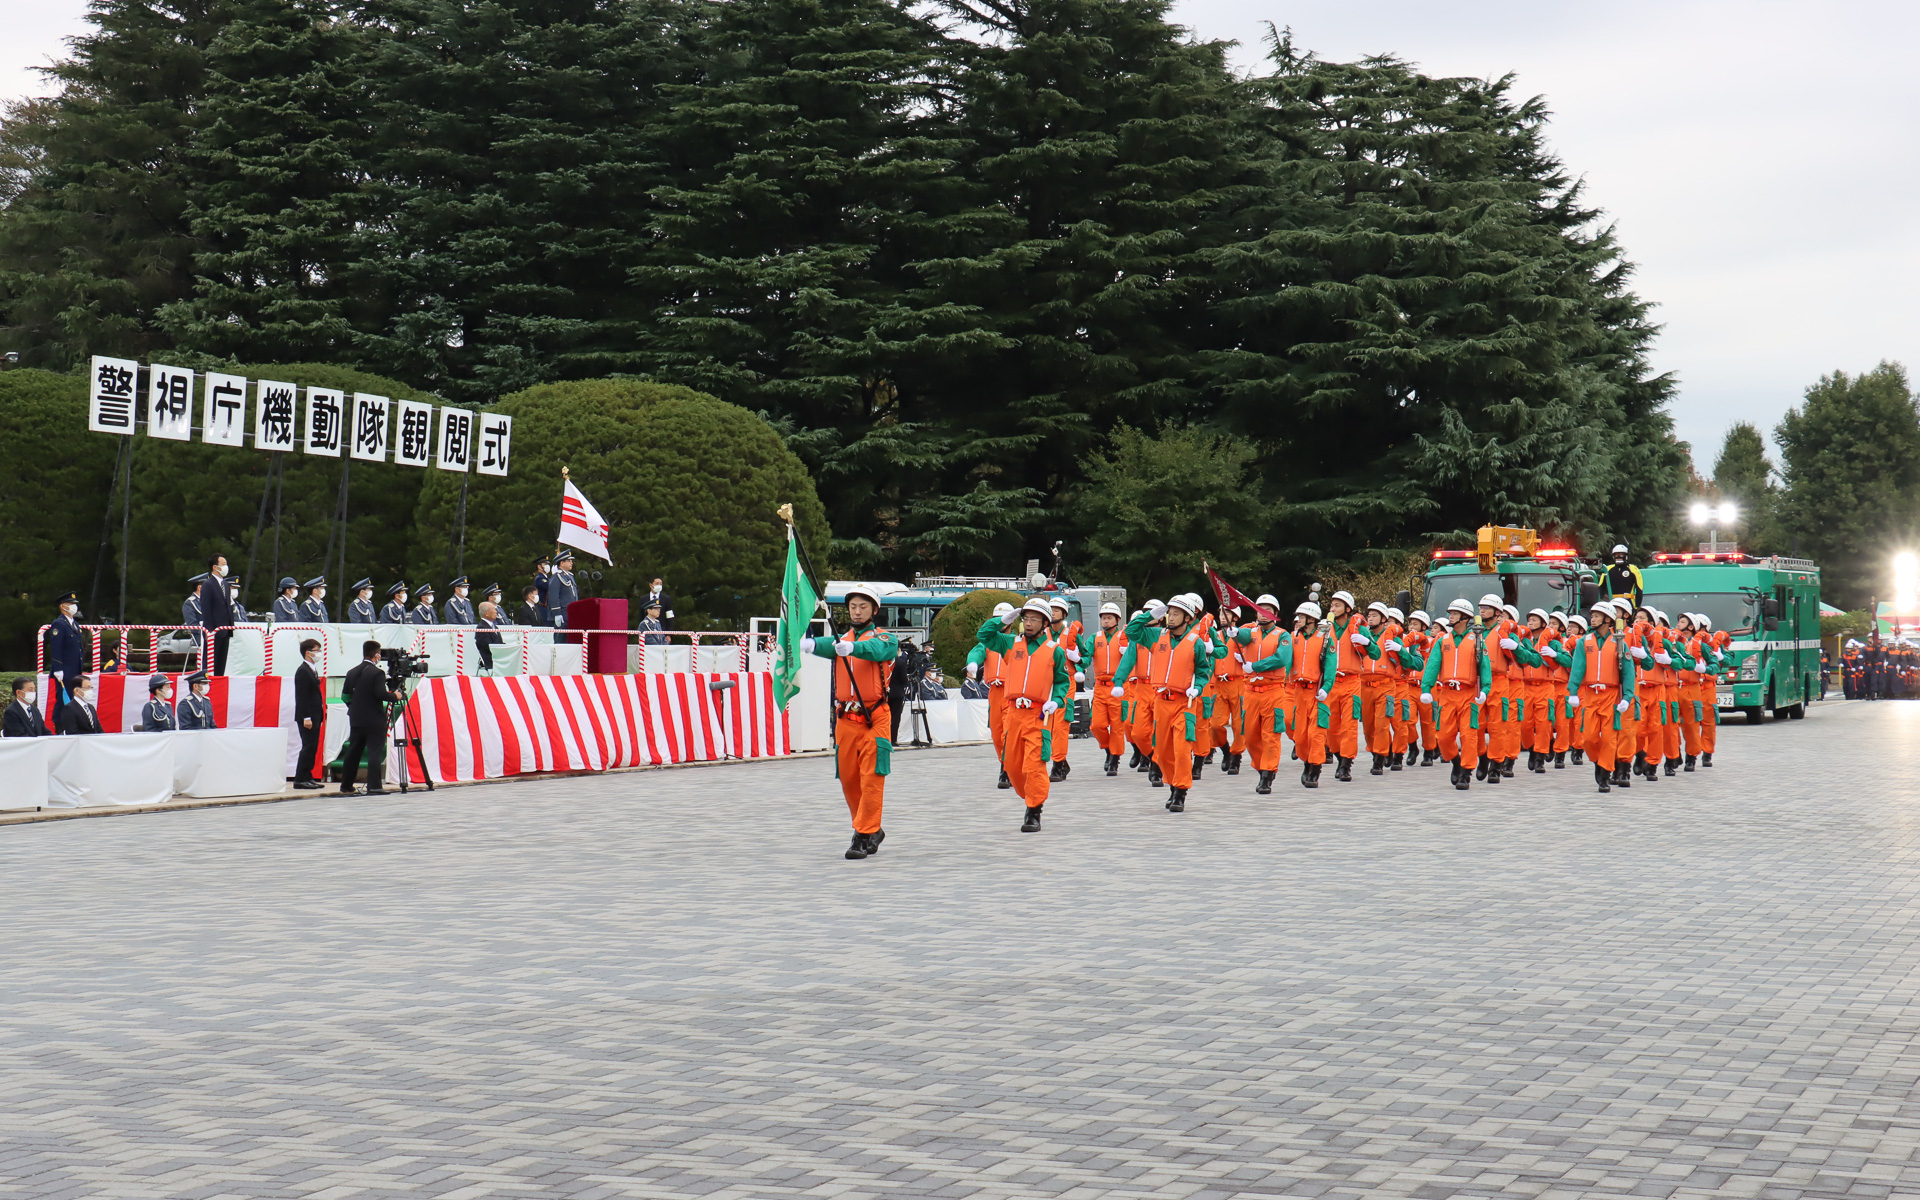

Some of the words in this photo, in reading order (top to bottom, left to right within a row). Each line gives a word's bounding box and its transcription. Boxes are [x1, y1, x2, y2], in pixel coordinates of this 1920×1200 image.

[97, 364, 508, 471] 警視庁機動隊観閲式
